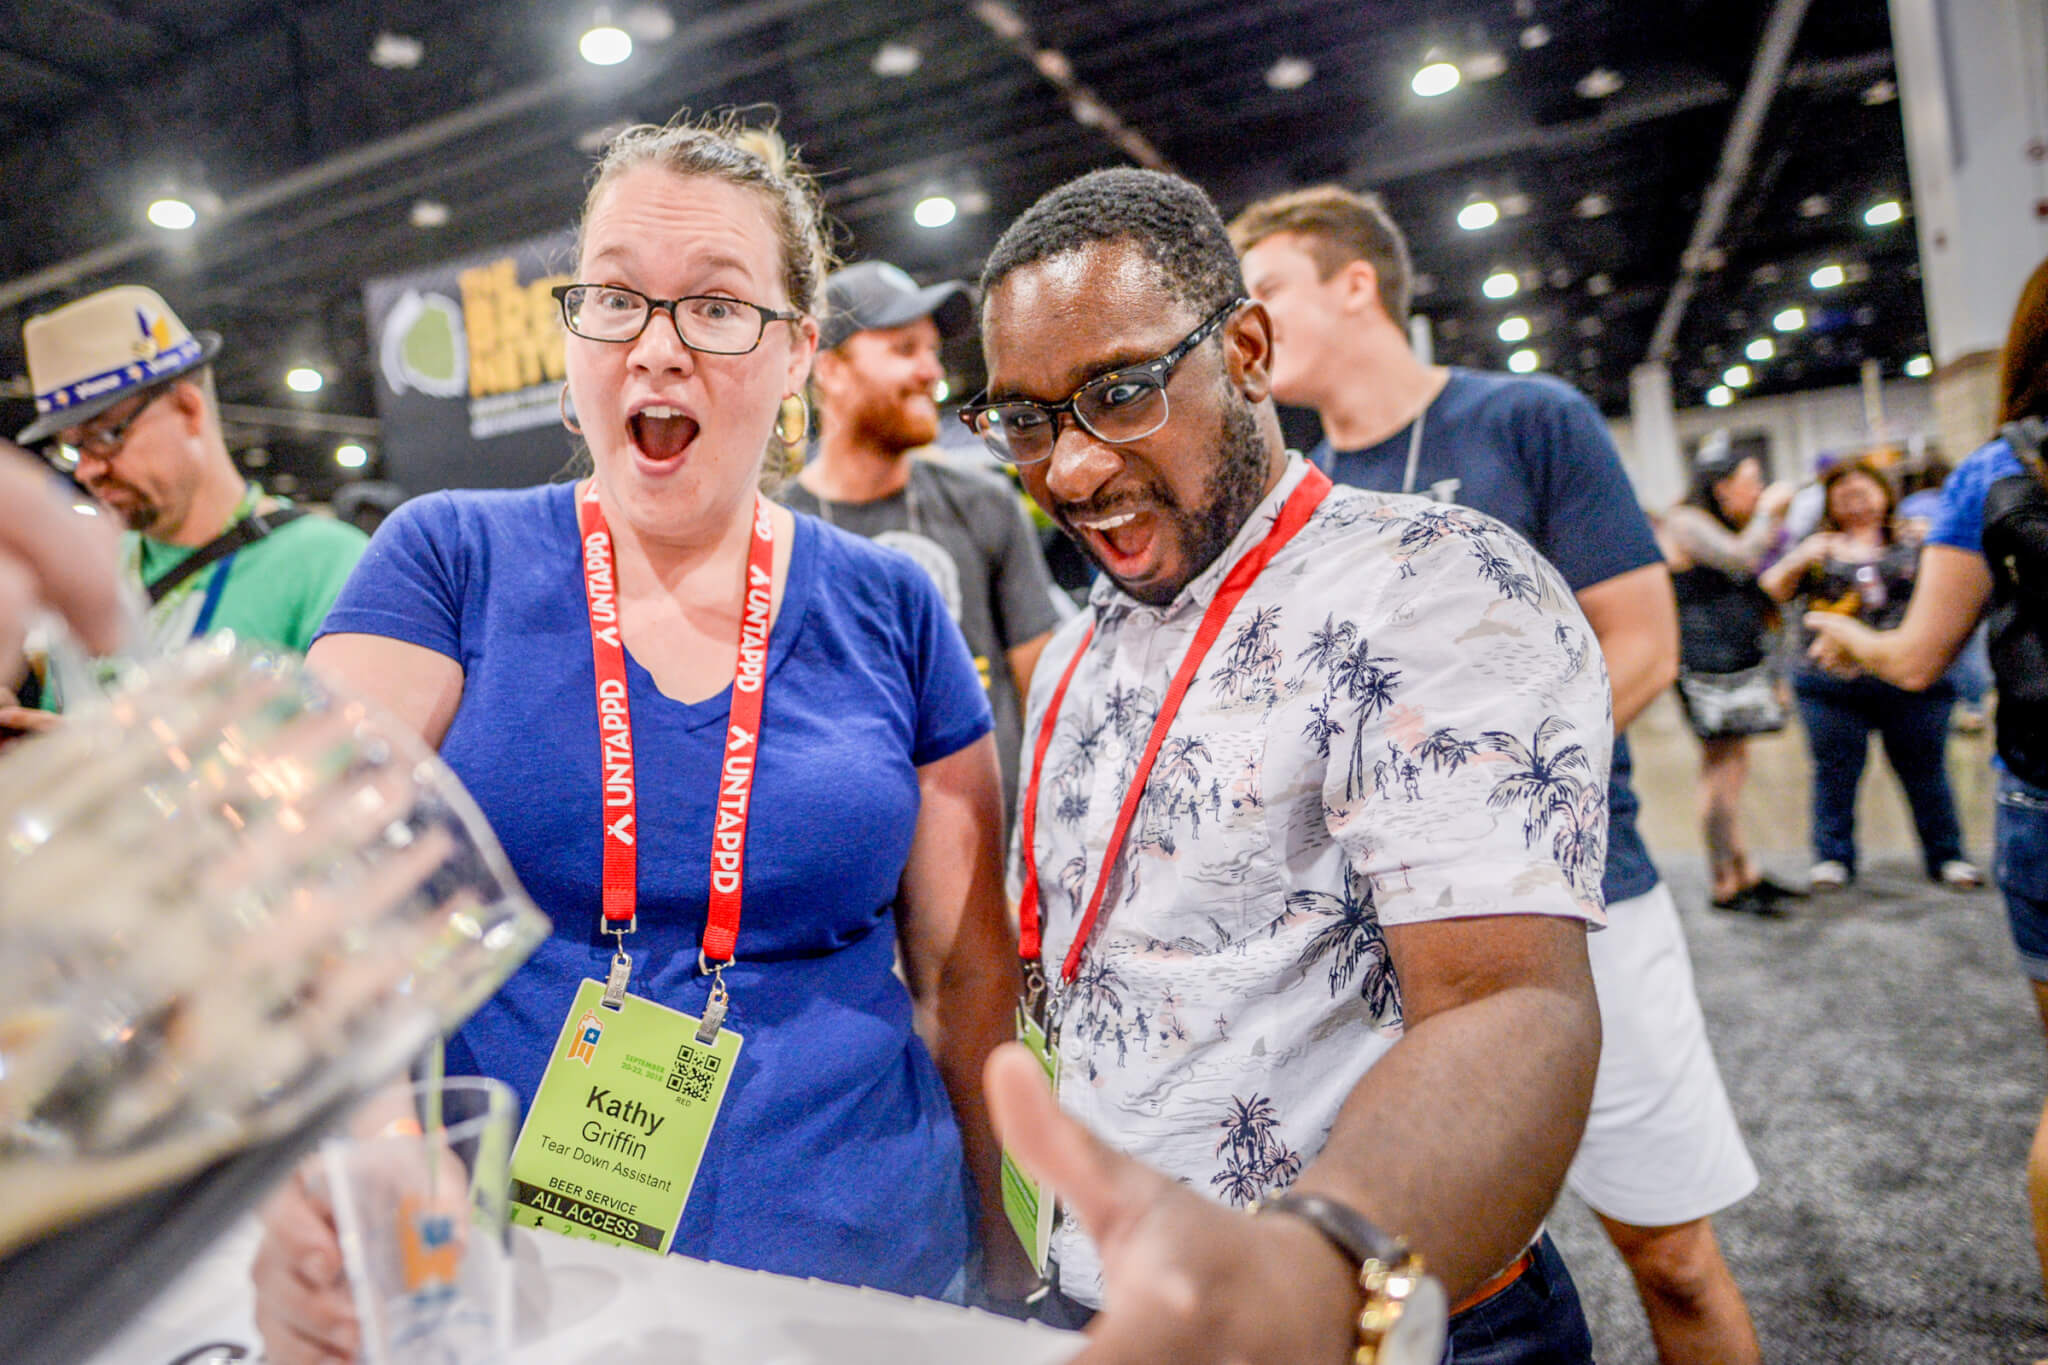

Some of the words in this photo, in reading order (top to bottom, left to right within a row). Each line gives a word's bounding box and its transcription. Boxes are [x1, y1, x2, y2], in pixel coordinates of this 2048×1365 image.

[585, 531, 617, 623] UNTAPPD
[736, 588, 770, 692] UNTAPPD
[600, 679, 633, 806] UNTAPPD
[713, 757, 753, 893] UNTAPPD
[586, 1086, 665, 1136] Kathy
[541, 1135, 569, 1157] Tear
[572, 1146, 609, 1171] Down
[612, 1161, 672, 1193] Assistant
[581, 1121, 647, 1160] Griffin
[531, 1191, 563, 1215] ALL
[566, 1203, 640, 1240] ACCESS
[549, 1176, 583, 1197] BEER
[585, 1190, 637, 1216] SERVICE
